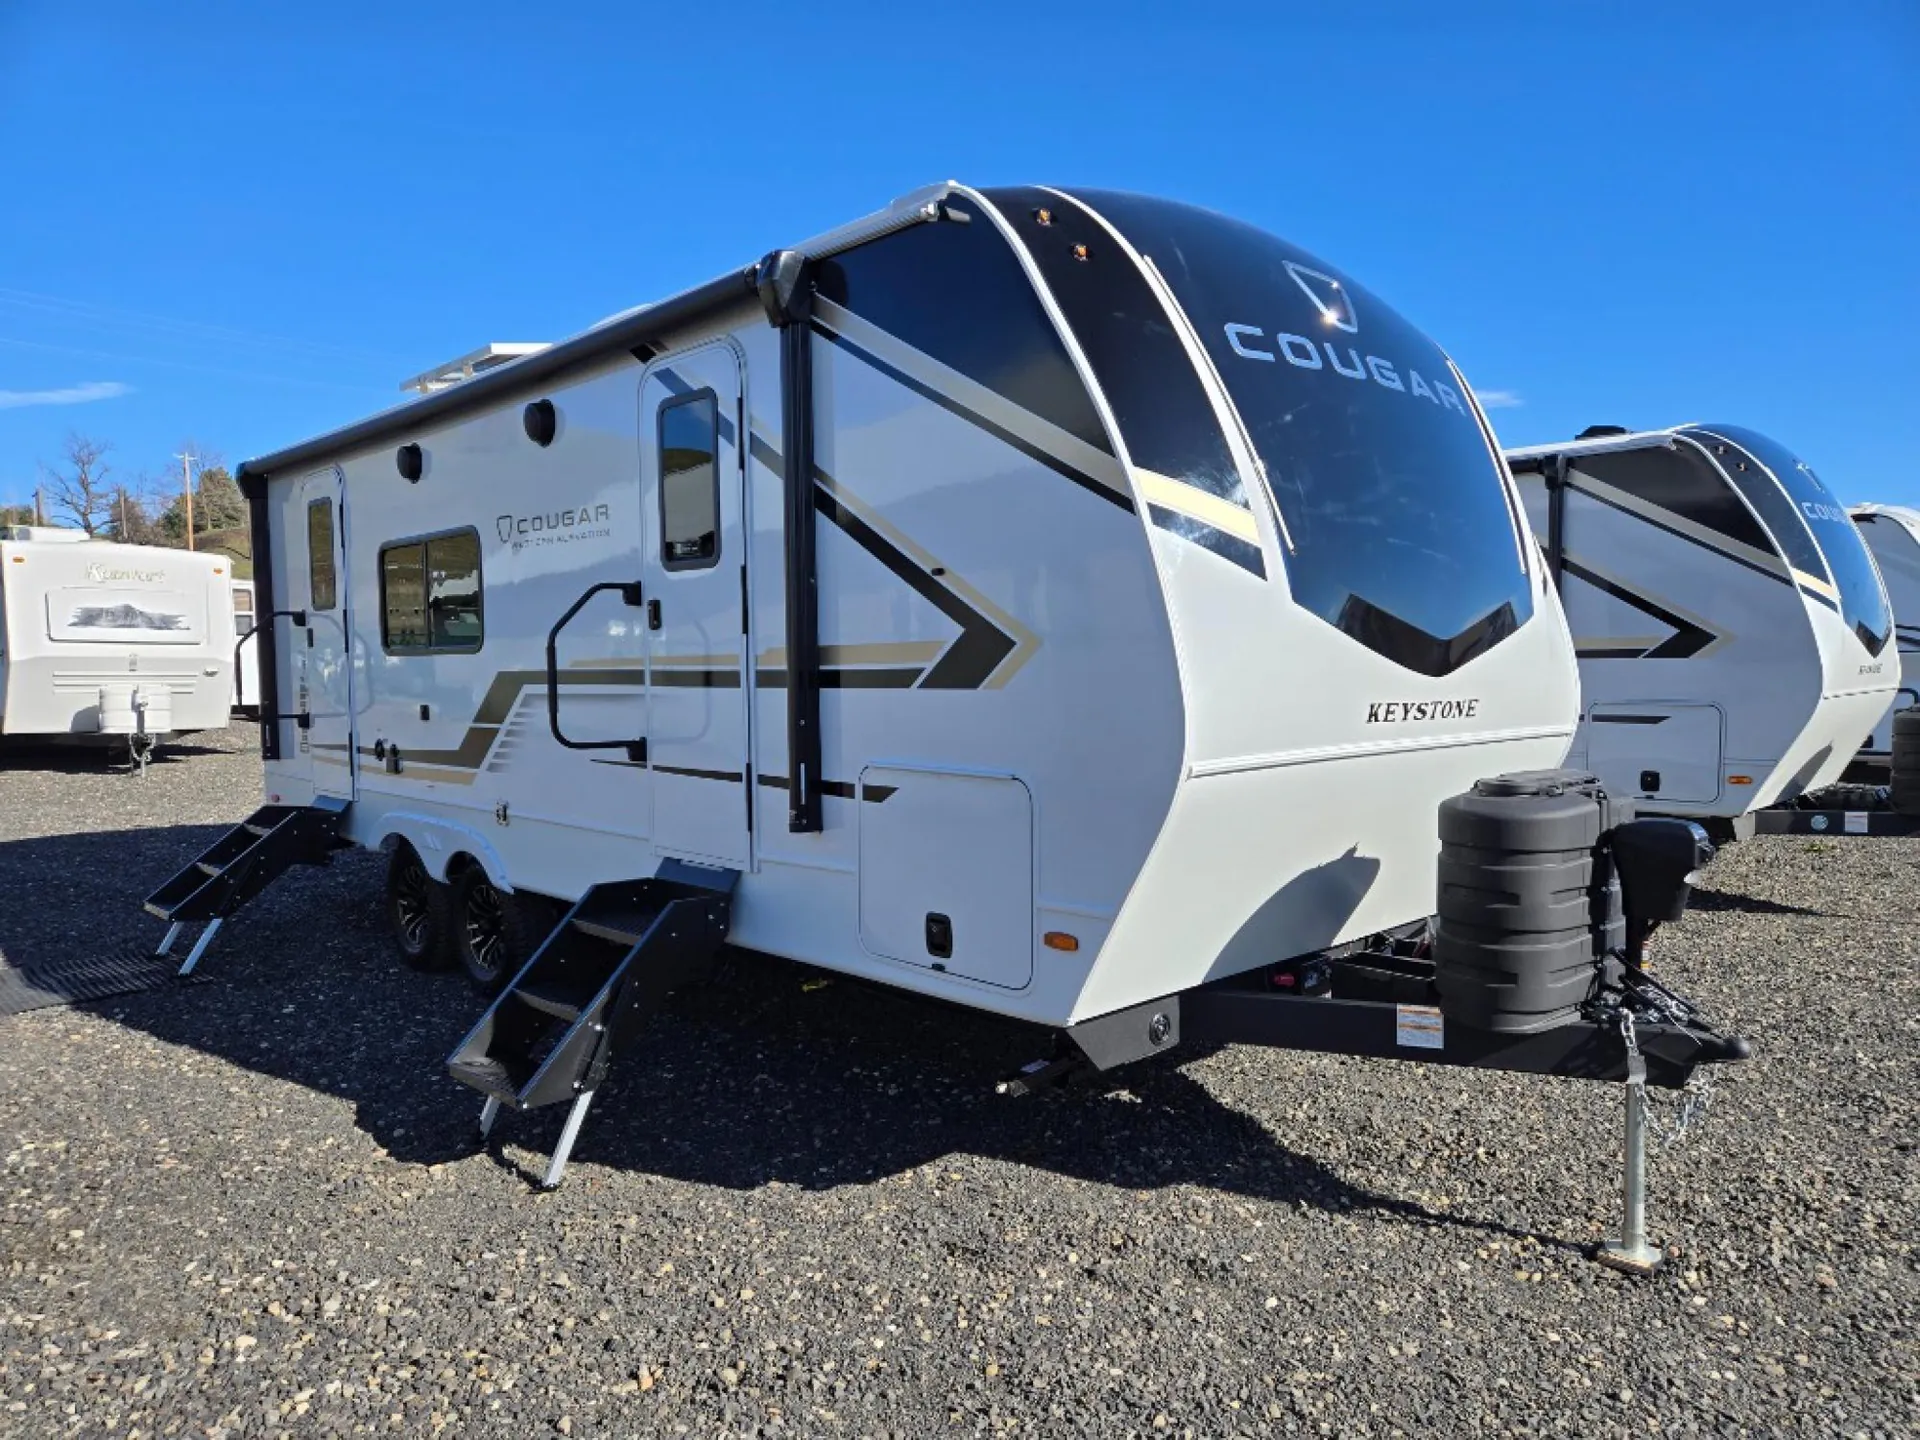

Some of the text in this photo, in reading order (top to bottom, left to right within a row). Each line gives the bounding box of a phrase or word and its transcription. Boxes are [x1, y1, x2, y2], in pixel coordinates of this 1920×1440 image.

[1223, 321, 1466, 417] COUGAR
[517, 503, 609, 535] COUGAR
[1801, 501, 1847, 524] COU
[1365, 698, 1480, 724] KEYSTONE
